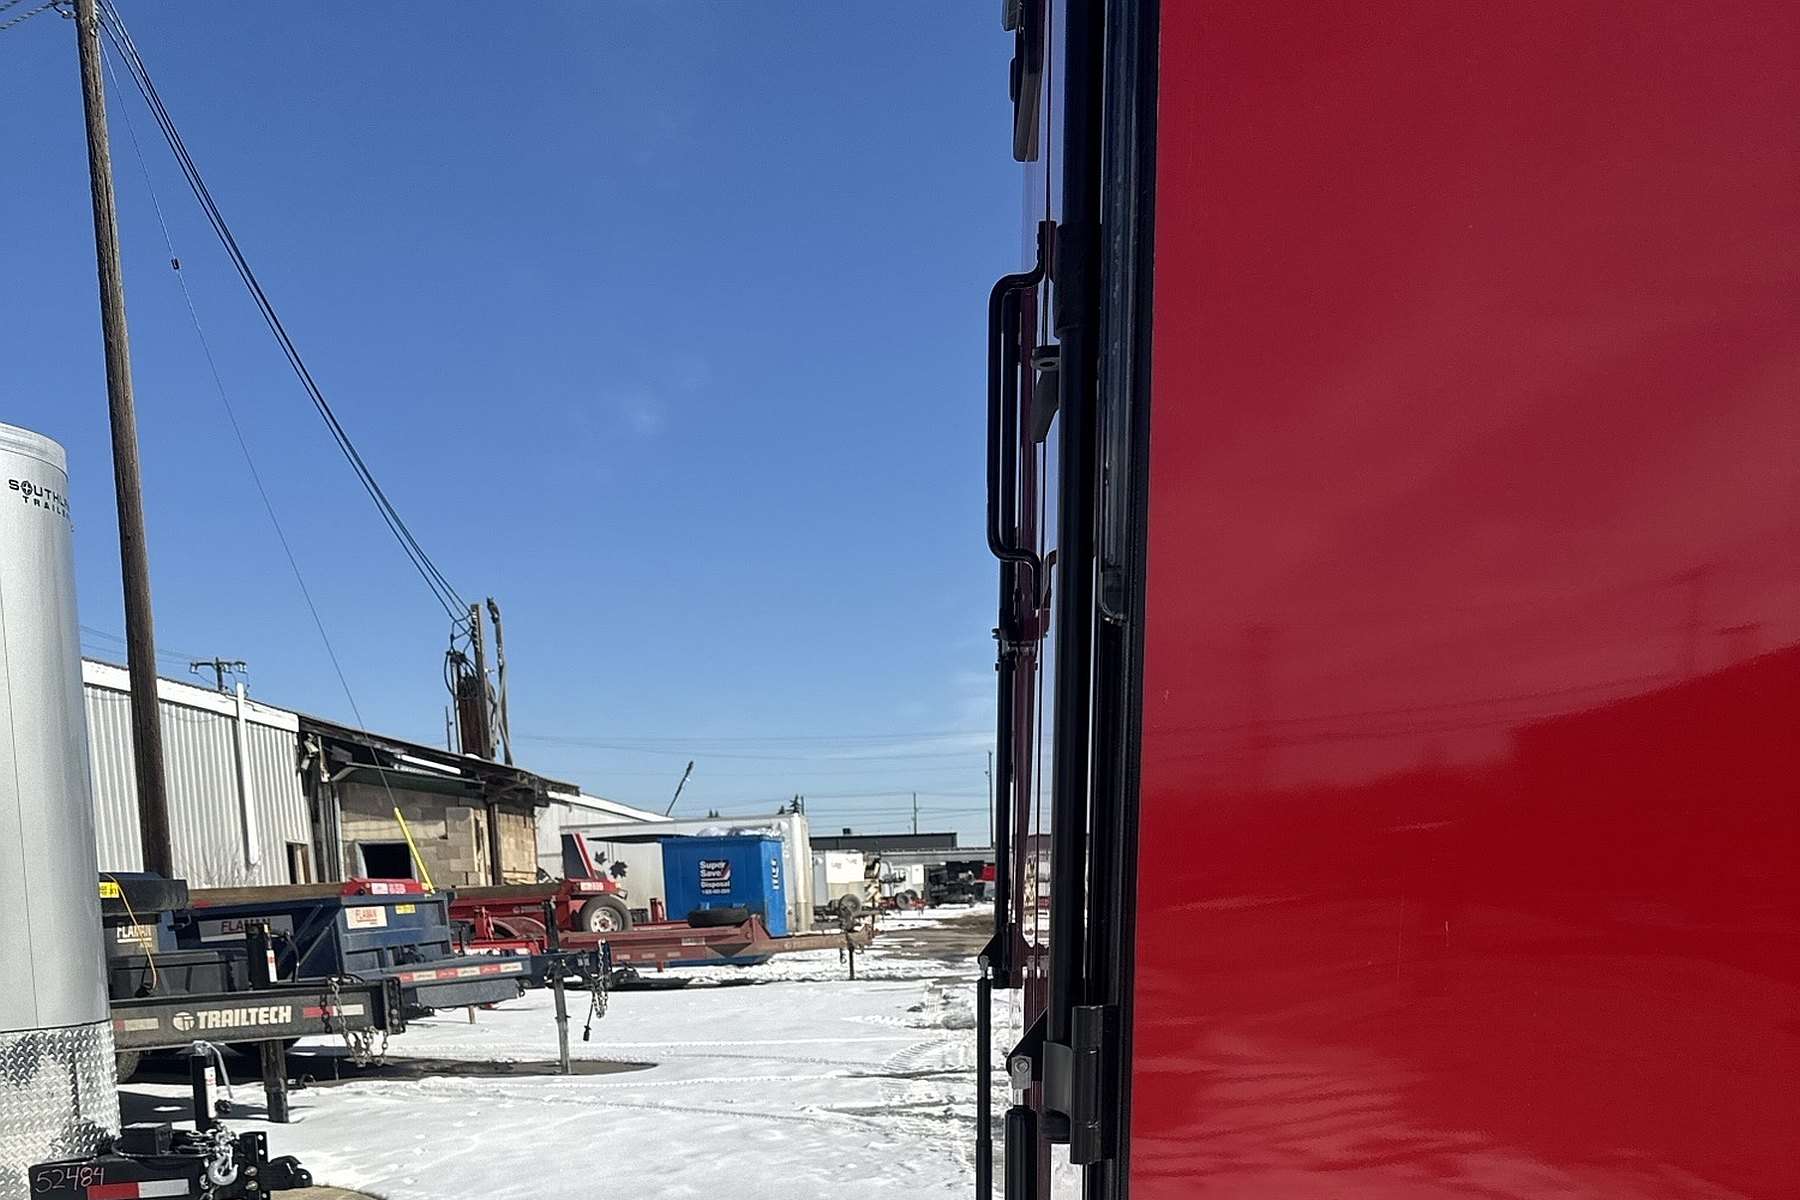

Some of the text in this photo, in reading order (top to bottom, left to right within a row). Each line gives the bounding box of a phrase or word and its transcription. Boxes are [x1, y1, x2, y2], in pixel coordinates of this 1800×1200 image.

[699, 861, 726, 870] Super
[197, 1005, 292, 1030] TRAILTECH
[35, 1167, 104, 1193] 52484
